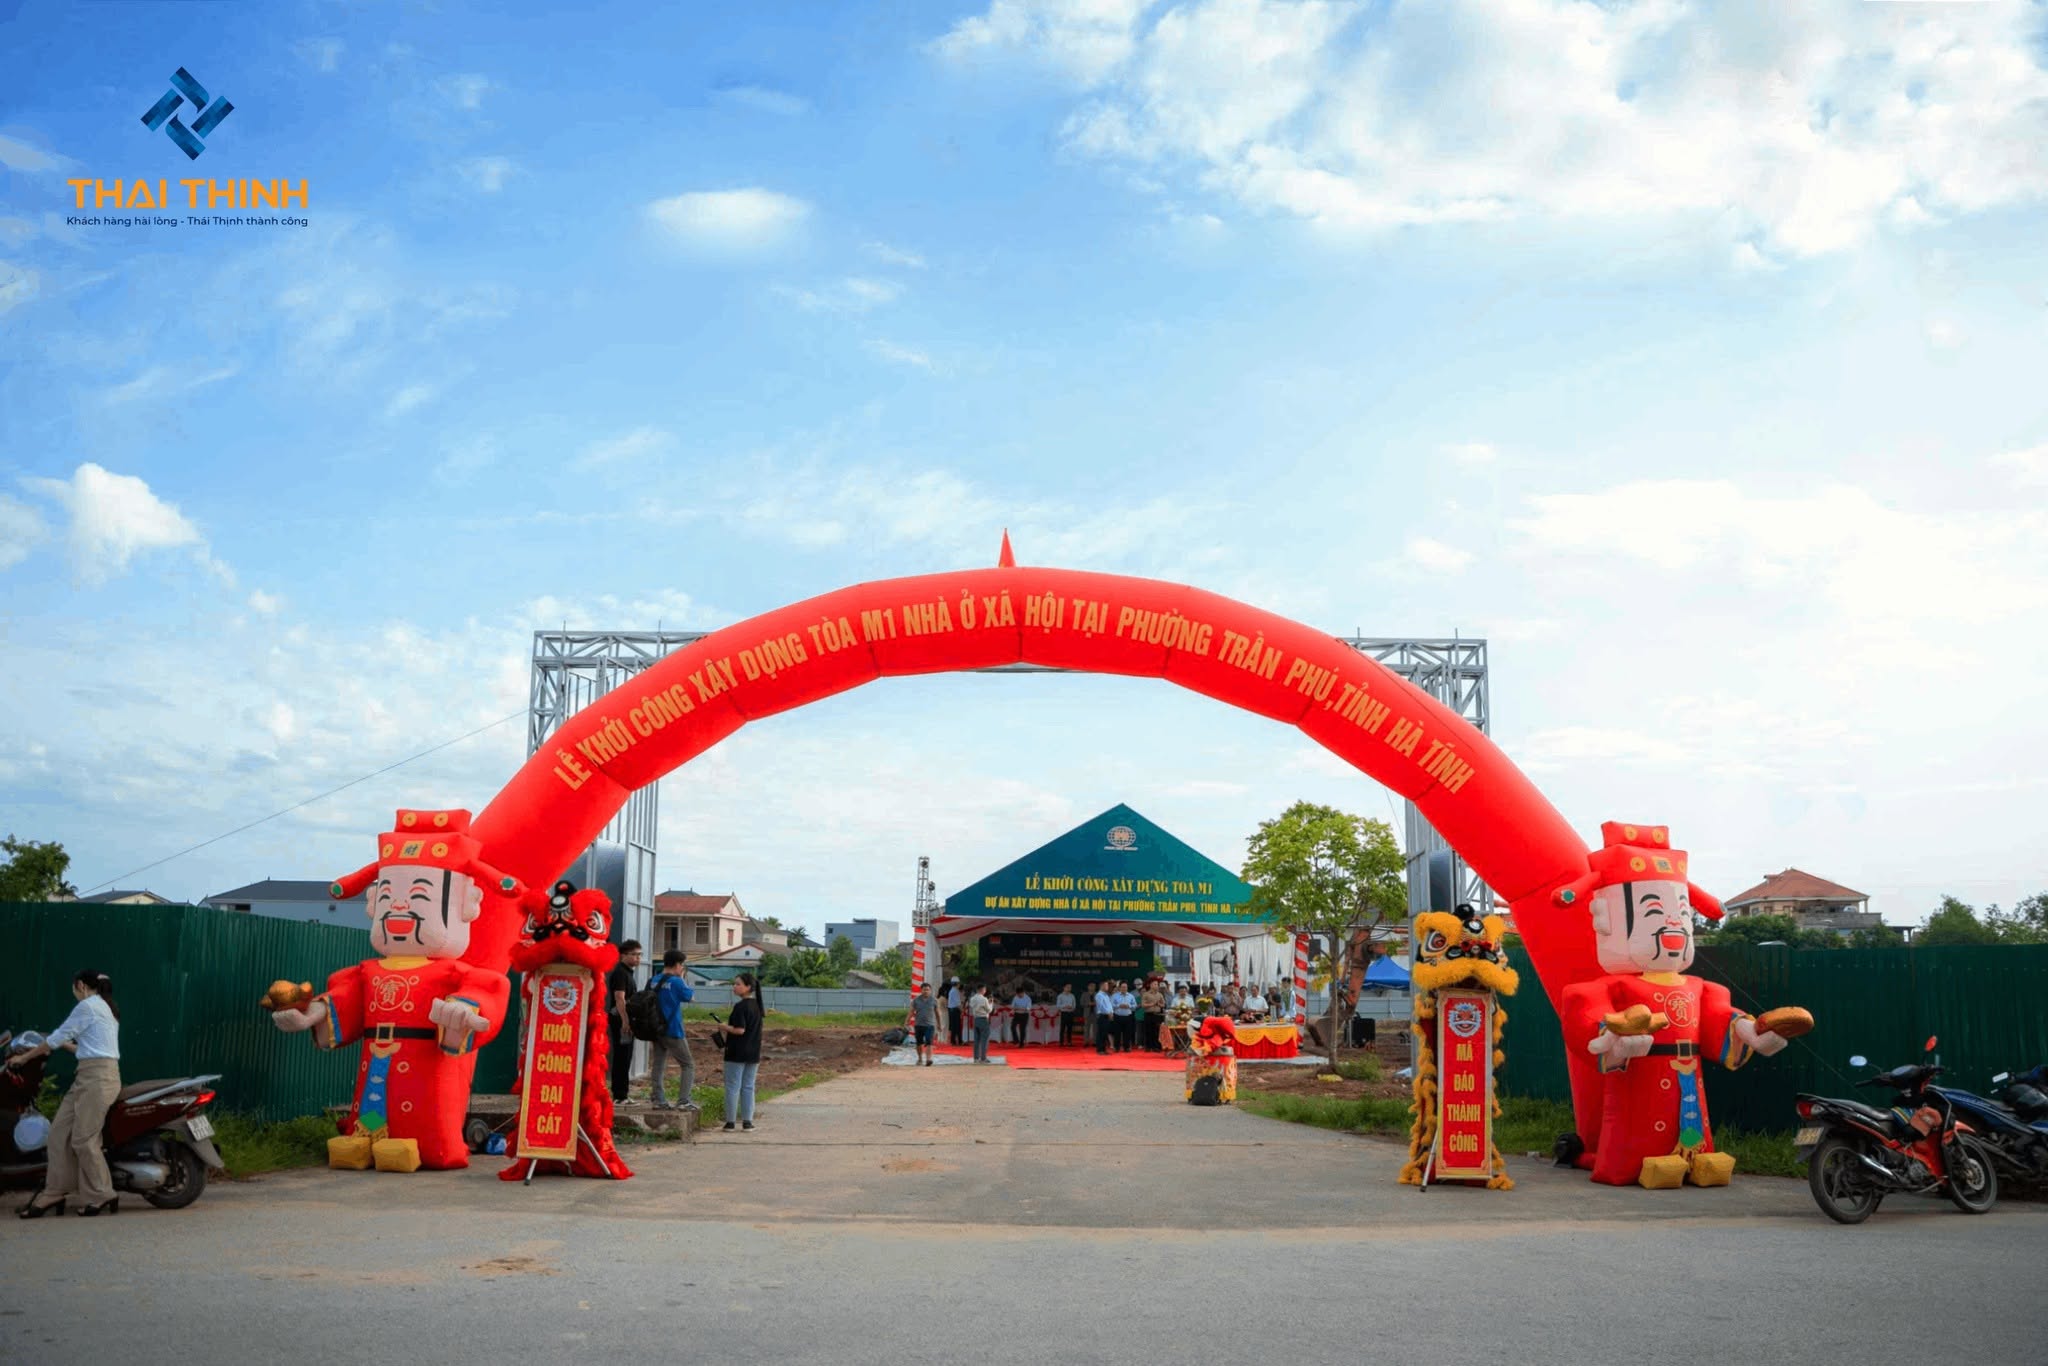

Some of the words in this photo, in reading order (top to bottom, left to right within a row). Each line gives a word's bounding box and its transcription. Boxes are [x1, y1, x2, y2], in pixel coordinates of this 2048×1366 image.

[553, 748, 592, 791] LỄ
[575, 716, 637, 767] KHỞI
[629, 683, 696, 737] CÔNG
[688, 656, 739, 703] XÂY
[738, 632, 808, 680] DỰNG
[808, 616, 858, 656] TÒA
[861, 608, 897, 642] M1
[903, 595, 954, 637] NHÀ
[959, 588, 976, 630] Ở
[982, 589, 1016, 628] XÃ
[1025, 591, 1065, 634] HỘI
[1072, 598, 1109, 638] TẠI
[1116, 606, 1213, 656] PHƯỜNG
[1217, 630, 1283, 681] TRẦN
[1384, 716, 1424, 759] HÀ
[1417, 739, 1476, 795] TĨNH
[1077, 875, 1108, 892] CÔNG
[1137, 878, 1168, 897] DỰNG
[542, 1019, 572, 1043] KHỞI
[537, 1051, 572, 1074] CÔNG
[1453, 1070, 1475, 1092] ĐÁO
[540, 1085, 563, 1108] ĐẠI
[536, 1112, 562, 1135] CÁT
[1447, 1101, 1481, 1123] THÀNH
[1449, 1130, 1478, 1153] CÔNG
